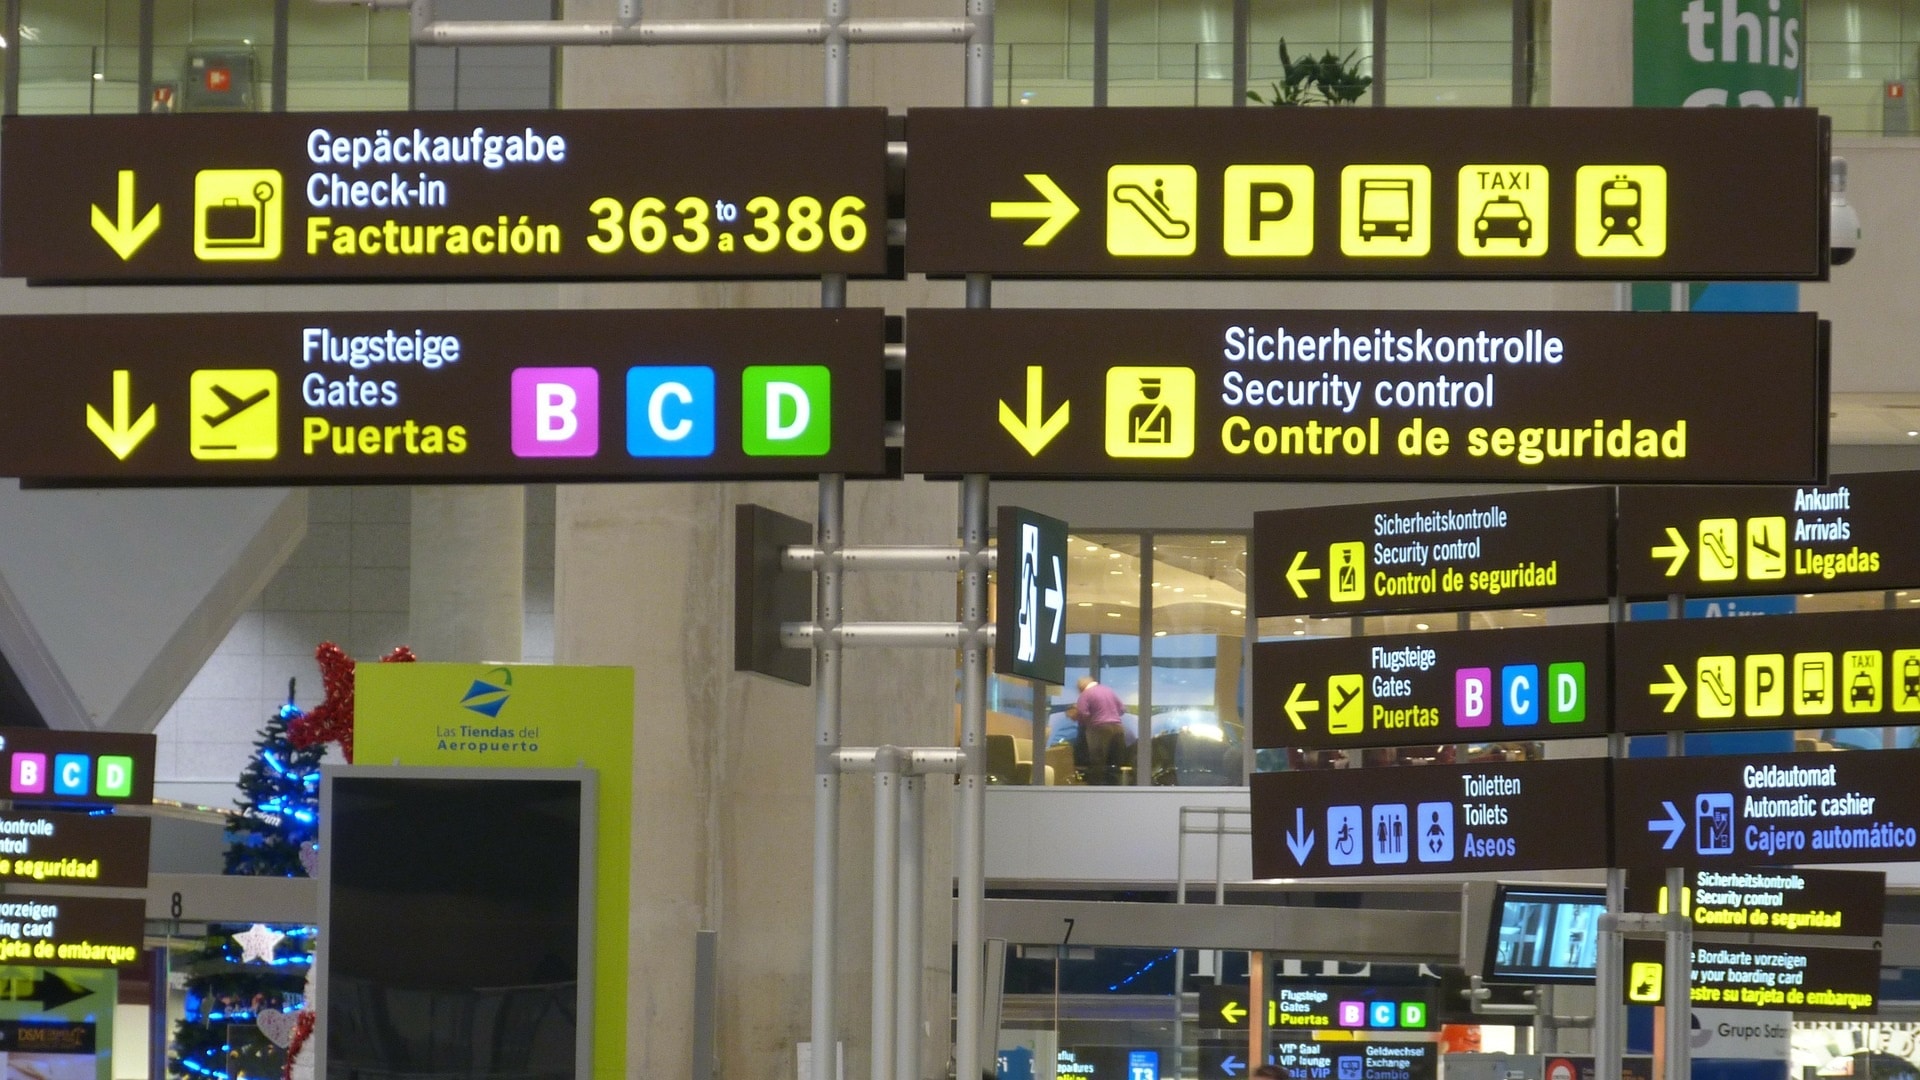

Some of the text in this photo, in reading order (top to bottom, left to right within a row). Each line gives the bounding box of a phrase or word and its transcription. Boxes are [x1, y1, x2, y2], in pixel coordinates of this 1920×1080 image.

[1680, 0, 1800, 70] this
[308, 128, 566, 169] Gepäckaufgabe
[307, 168, 446, 208] Check-in
[1478, 172, 1529, 189] TAXI
[716, 200, 737, 221] to
[1250, 183, 1293, 241] P
[307, 216, 560, 254] Facturación
[587, 197, 709, 253] 363
[743, 196, 866, 252] 386
[718, 233, 733, 251] a
[303, 328, 460, 369] Flugsteige
[1224, 327, 1563, 364] Sicherheitskontrolle
[303, 373, 398, 407] Gates
[1222, 371, 1493, 413] Security control
[537, 382, 810, 441] B C D
[304, 418, 466, 454] Puertas
[1222, 416, 1686, 464] Control de seguridad
[1795, 487, 1850, 511] Ankunft
[1375, 506, 1507, 535] Sicherheitskontrolle
[1795, 517, 1850, 541] Arrivals
[1374, 537, 1480, 566] Security control
[1796, 547, 1879, 579] Llegadas
[1374, 561, 1556, 596] Control de seguridad
[1372, 646, 1435, 672] Flugsteige
[1851, 654, 1876, 669] TAXI
[1373, 676, 1411, 697] Gates
[1466, 674, 1577, 717] B C D
[1757, 667, 1774, 706] P
[1373, 705, 1438, 728] Puertas
[436, 725, 539, 738] Las Tiendas del
[437, 739, 539, 753] Aeropuerto
[21, 760, 124, 788] B C D
[1462, 775, 1520, 796] Toiletten
[1744, 765, 1836, 788] Geldautomat
[1463, 804, 1507, 825] Toilets
[1744, 793, 1875, 818] Automatic cashier
[1464, 833, 1515, 857] Aseos
[1745, 822, 1916, 855] Cajero automático
[15, 858, 98, 879] seguridad
[1697, 872, 1804, 891] Sicherheitskontrolle
[171, 892, 182, 918] 8
[1696, 889, 1783, 909] Security control
[22, 919, 53, 938] card
[1695, 906, 1841, 929] Control de seguridad
[1063, 918, 1075, 944] 7
[33, 938, 55, 958] de
[58, 941, 136, 964] embarque
[1698, 949, 1752, 965] Bordkarte
[1754, 953, 1806, 970] vorzeigen
[1700, 970, 1725, 983] your
[1728, 968, 1775, 986] boarding
[1778, 971, 1803, 984] card
[1280, 1001, 1310, 1012] Gates
[1281, 989, 1328, 1003] Flugsteige
[1722, 987, 1740, 1002] su
[1741, 987, 1784, 1006] tarjeta
[1787, 988, 1804, 1004] de
[1806, 990, 1872, 1009] embarque
[1280, 1013, 1330, 1026] Puertas
[1345, 1005, 1422, 1024] B C D
[1718, 1022, 1762, 1041] Grupo
[1280, 1055, 1297, 1066] VIP
[1366, 1046, 1425, 1057] Geldwechsel
[1366, 1058, 1411, 1069] Exchange
[1288, 1067, 1331, 1079] ala VIP
